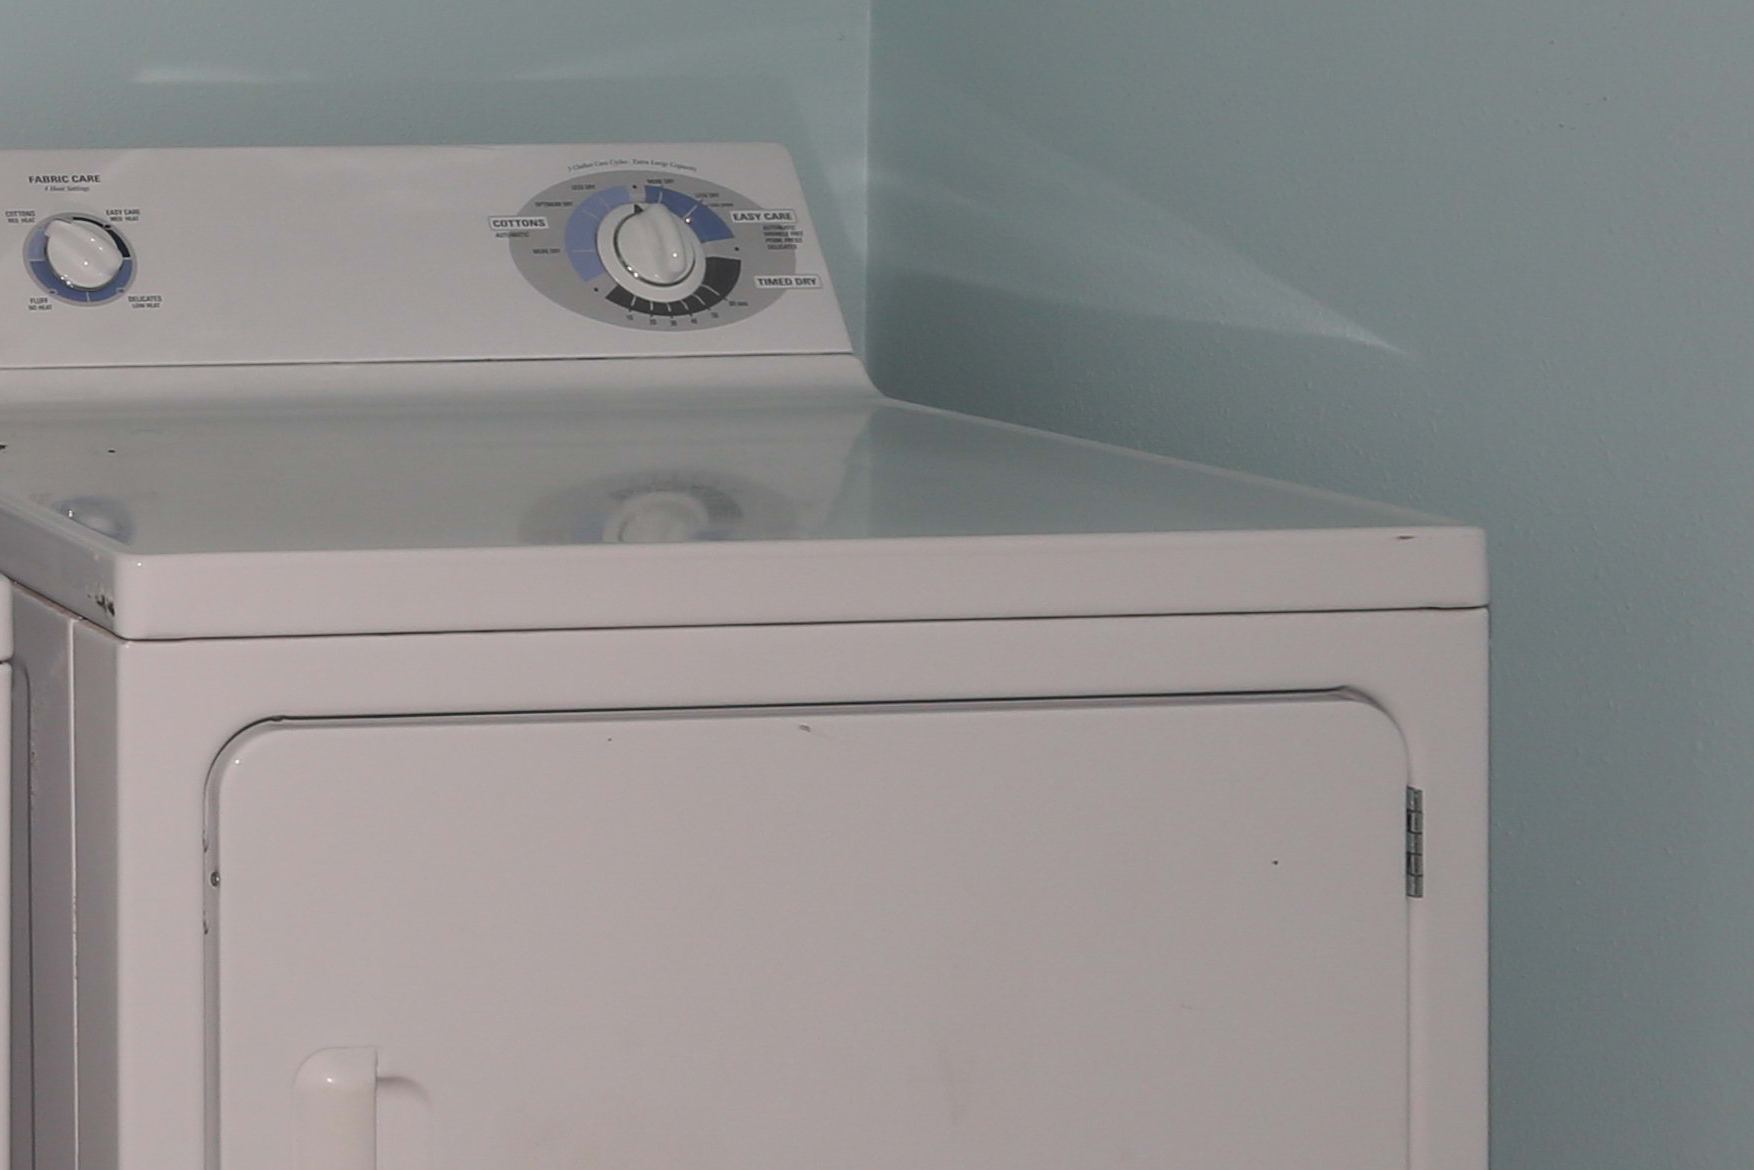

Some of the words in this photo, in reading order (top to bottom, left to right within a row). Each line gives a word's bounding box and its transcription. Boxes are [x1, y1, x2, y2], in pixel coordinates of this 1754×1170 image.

[28, 175, 70, 184] FABRIC
[72, 175, 102, 183] CARE
[733, 213, 761, 222] EASY
[763, 212, 793, 220] CARE
[492, 219, 546, 227] COTTONS
[757, 278, 793, 286] TIMED
[795, 278, 817, 286] DRY
